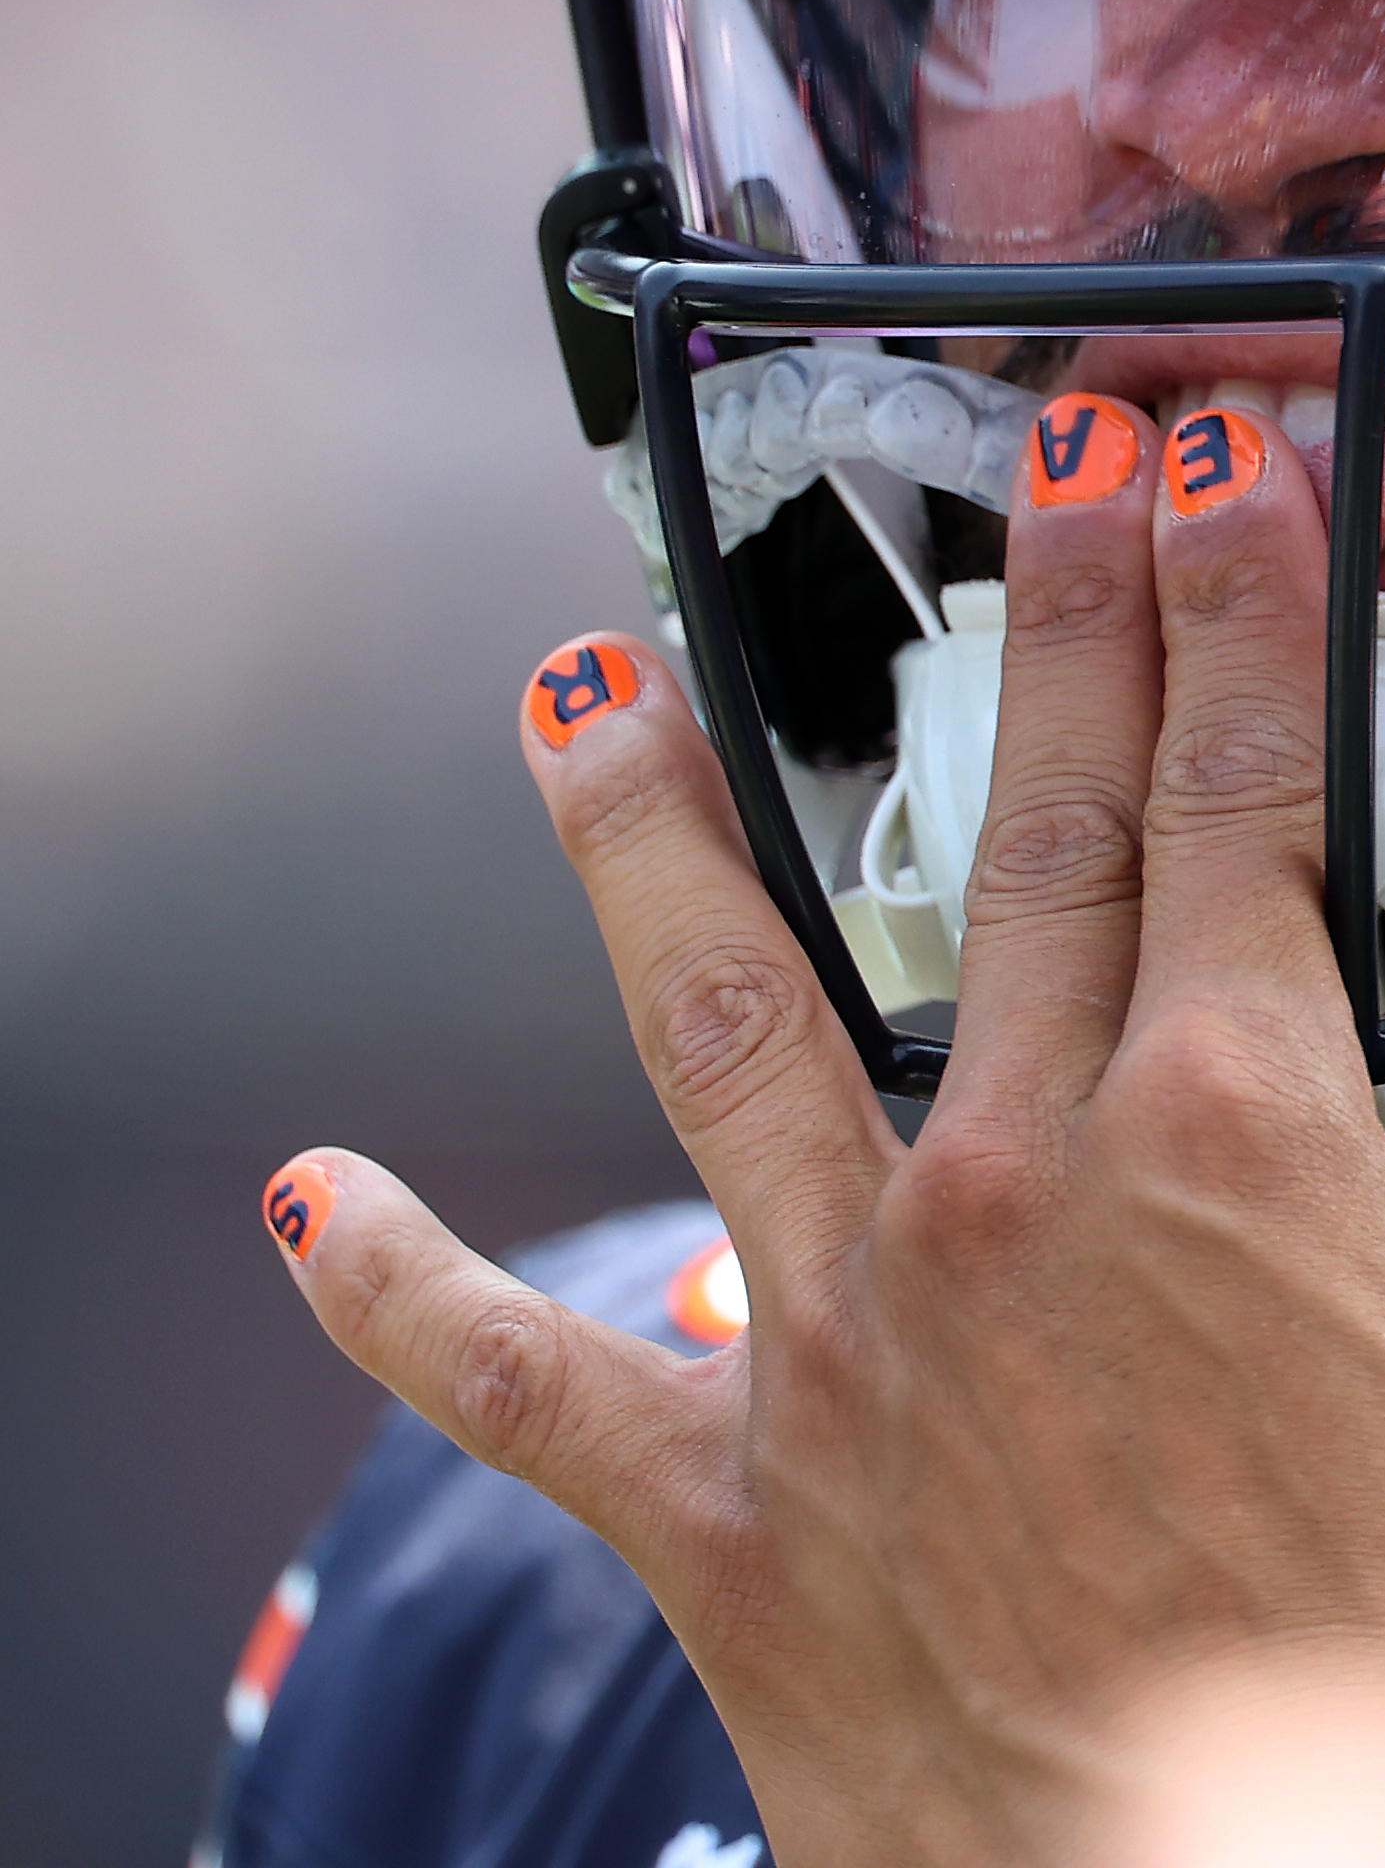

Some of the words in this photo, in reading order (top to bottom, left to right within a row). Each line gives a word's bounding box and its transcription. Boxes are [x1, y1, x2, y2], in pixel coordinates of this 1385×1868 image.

[1039, 408, 1097, 480] A
[1178, 415, 1232, 494] E
[539, 647, 611, 724] R
[270, 1182, 308, 1250] S
